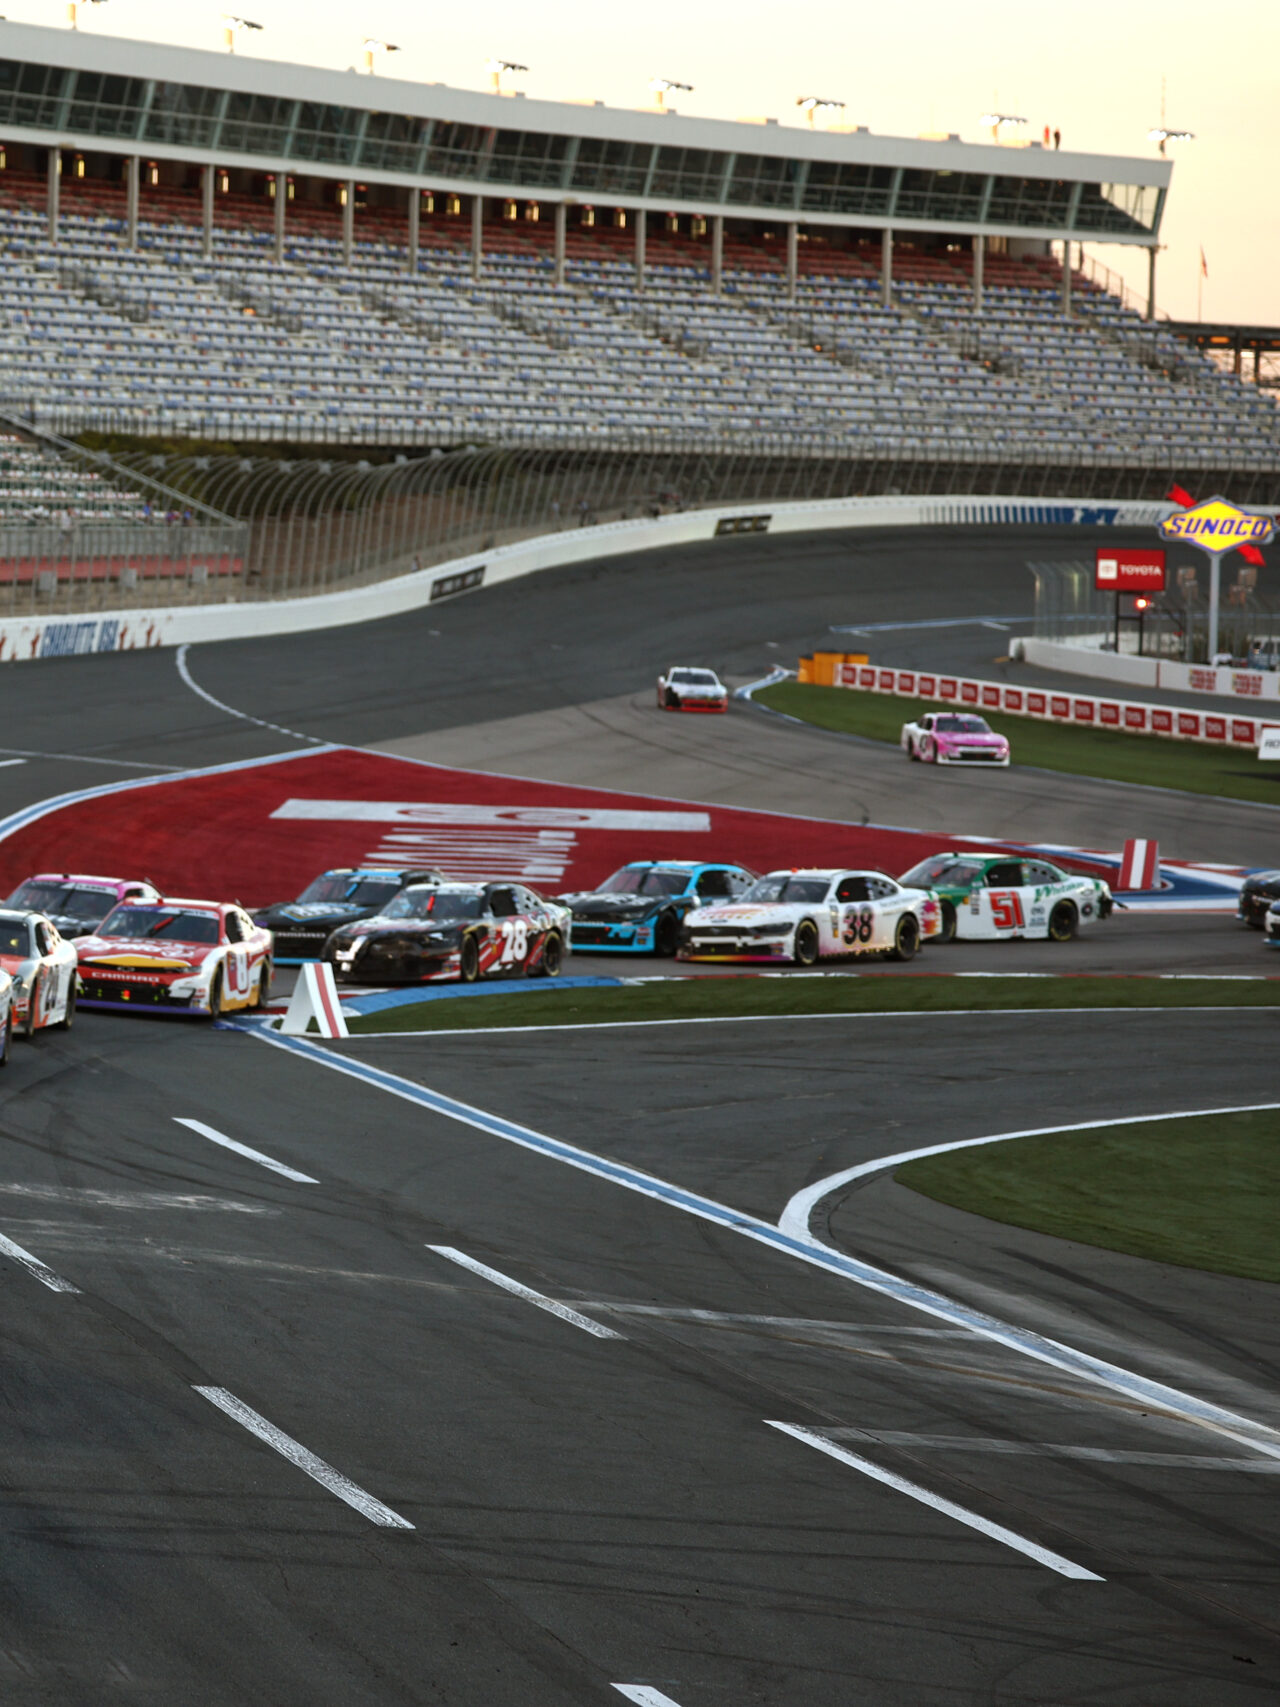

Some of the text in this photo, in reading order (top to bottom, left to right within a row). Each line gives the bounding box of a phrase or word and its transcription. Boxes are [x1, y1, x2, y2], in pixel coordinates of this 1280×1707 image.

[1169, 517, 1268, 536] SUNOCO
[1119, 564, 1161, 576] TOYOTA
[41, 619, 119, 657] CHARLOTTE USA
[989, 891, 1025, 929] 51
[842, 905, 873, 944] 38
[91, 971, 160, 982] CAMARO
